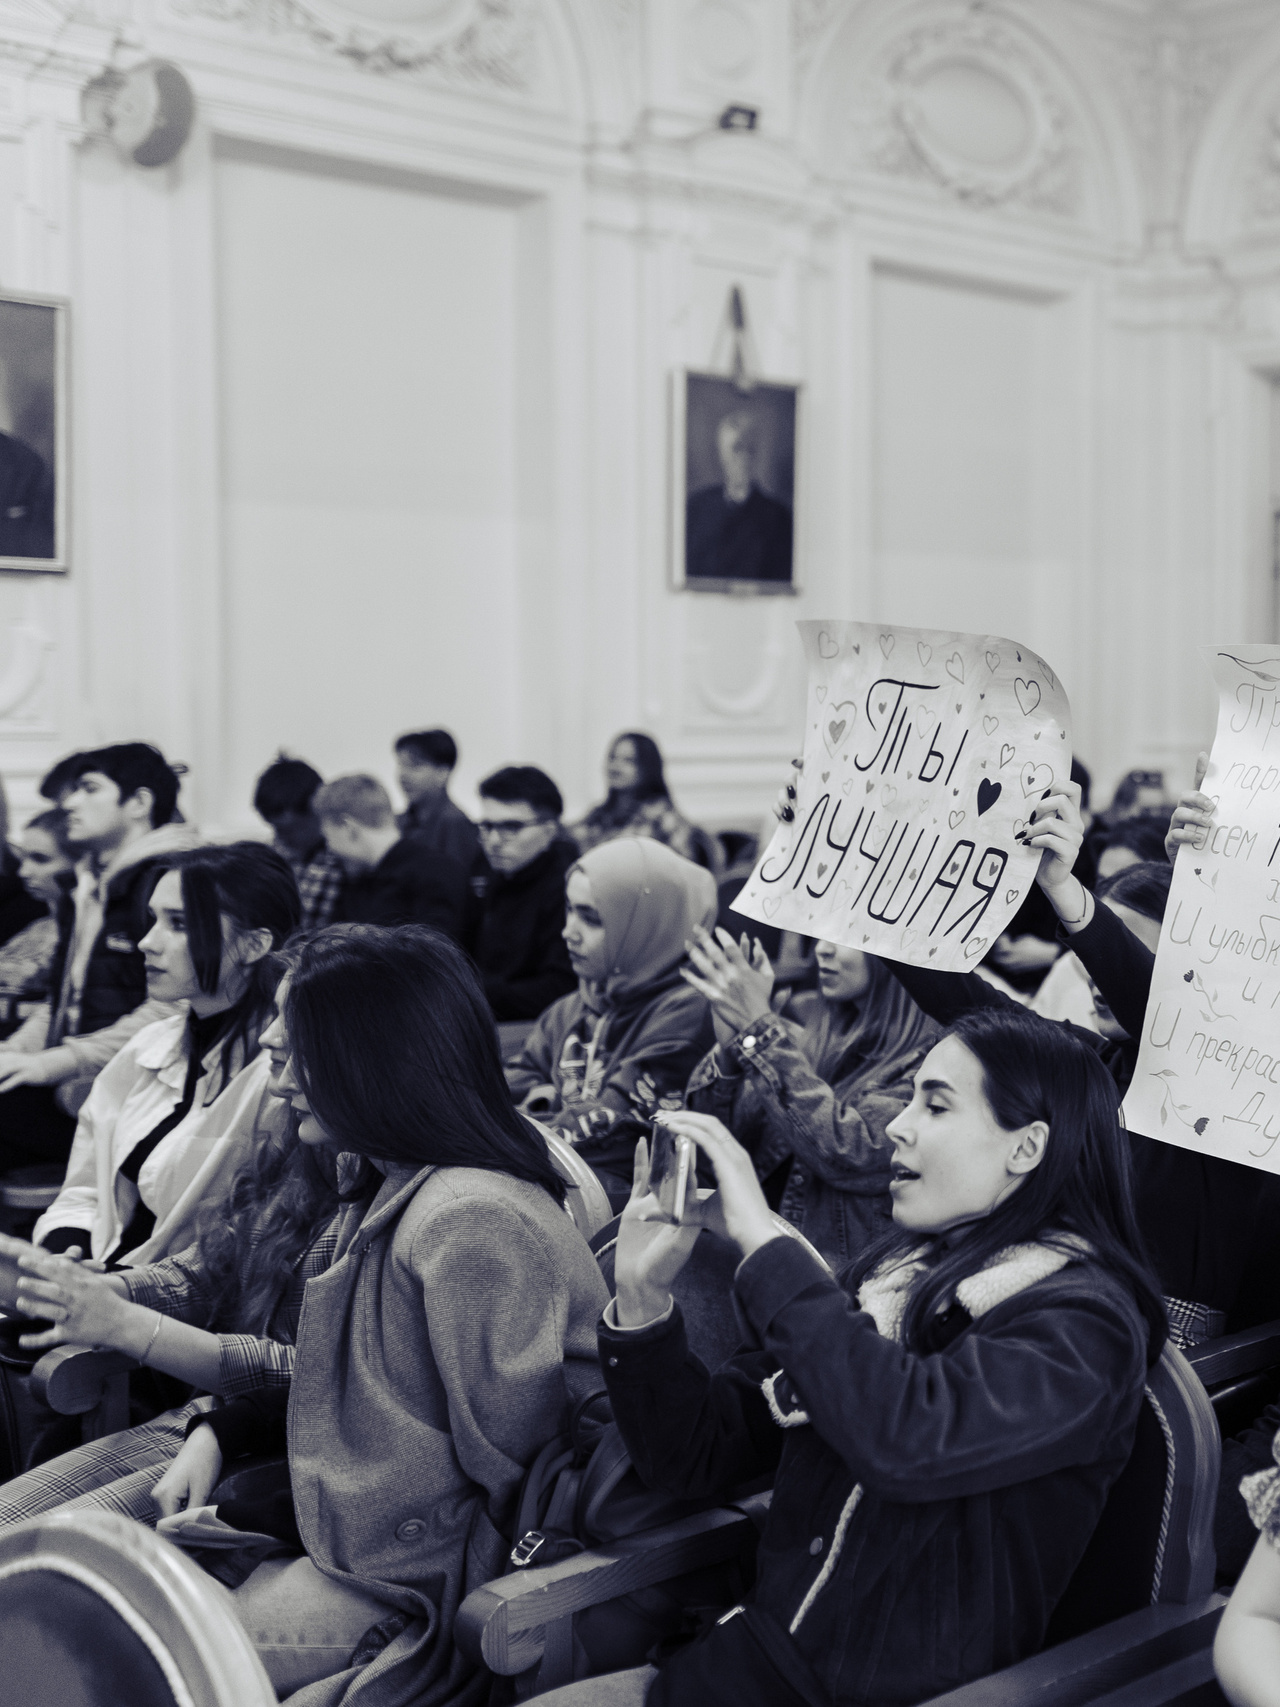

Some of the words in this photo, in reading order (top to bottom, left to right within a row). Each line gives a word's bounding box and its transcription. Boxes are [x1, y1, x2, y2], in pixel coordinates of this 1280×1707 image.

[759, 793, 1010, 944] ЛУЧШАЯ
[1169, 900, 1203, 947] И
[1241, 976, 1263, 1005] и
[1148, 1001, 1182, 1051] И
